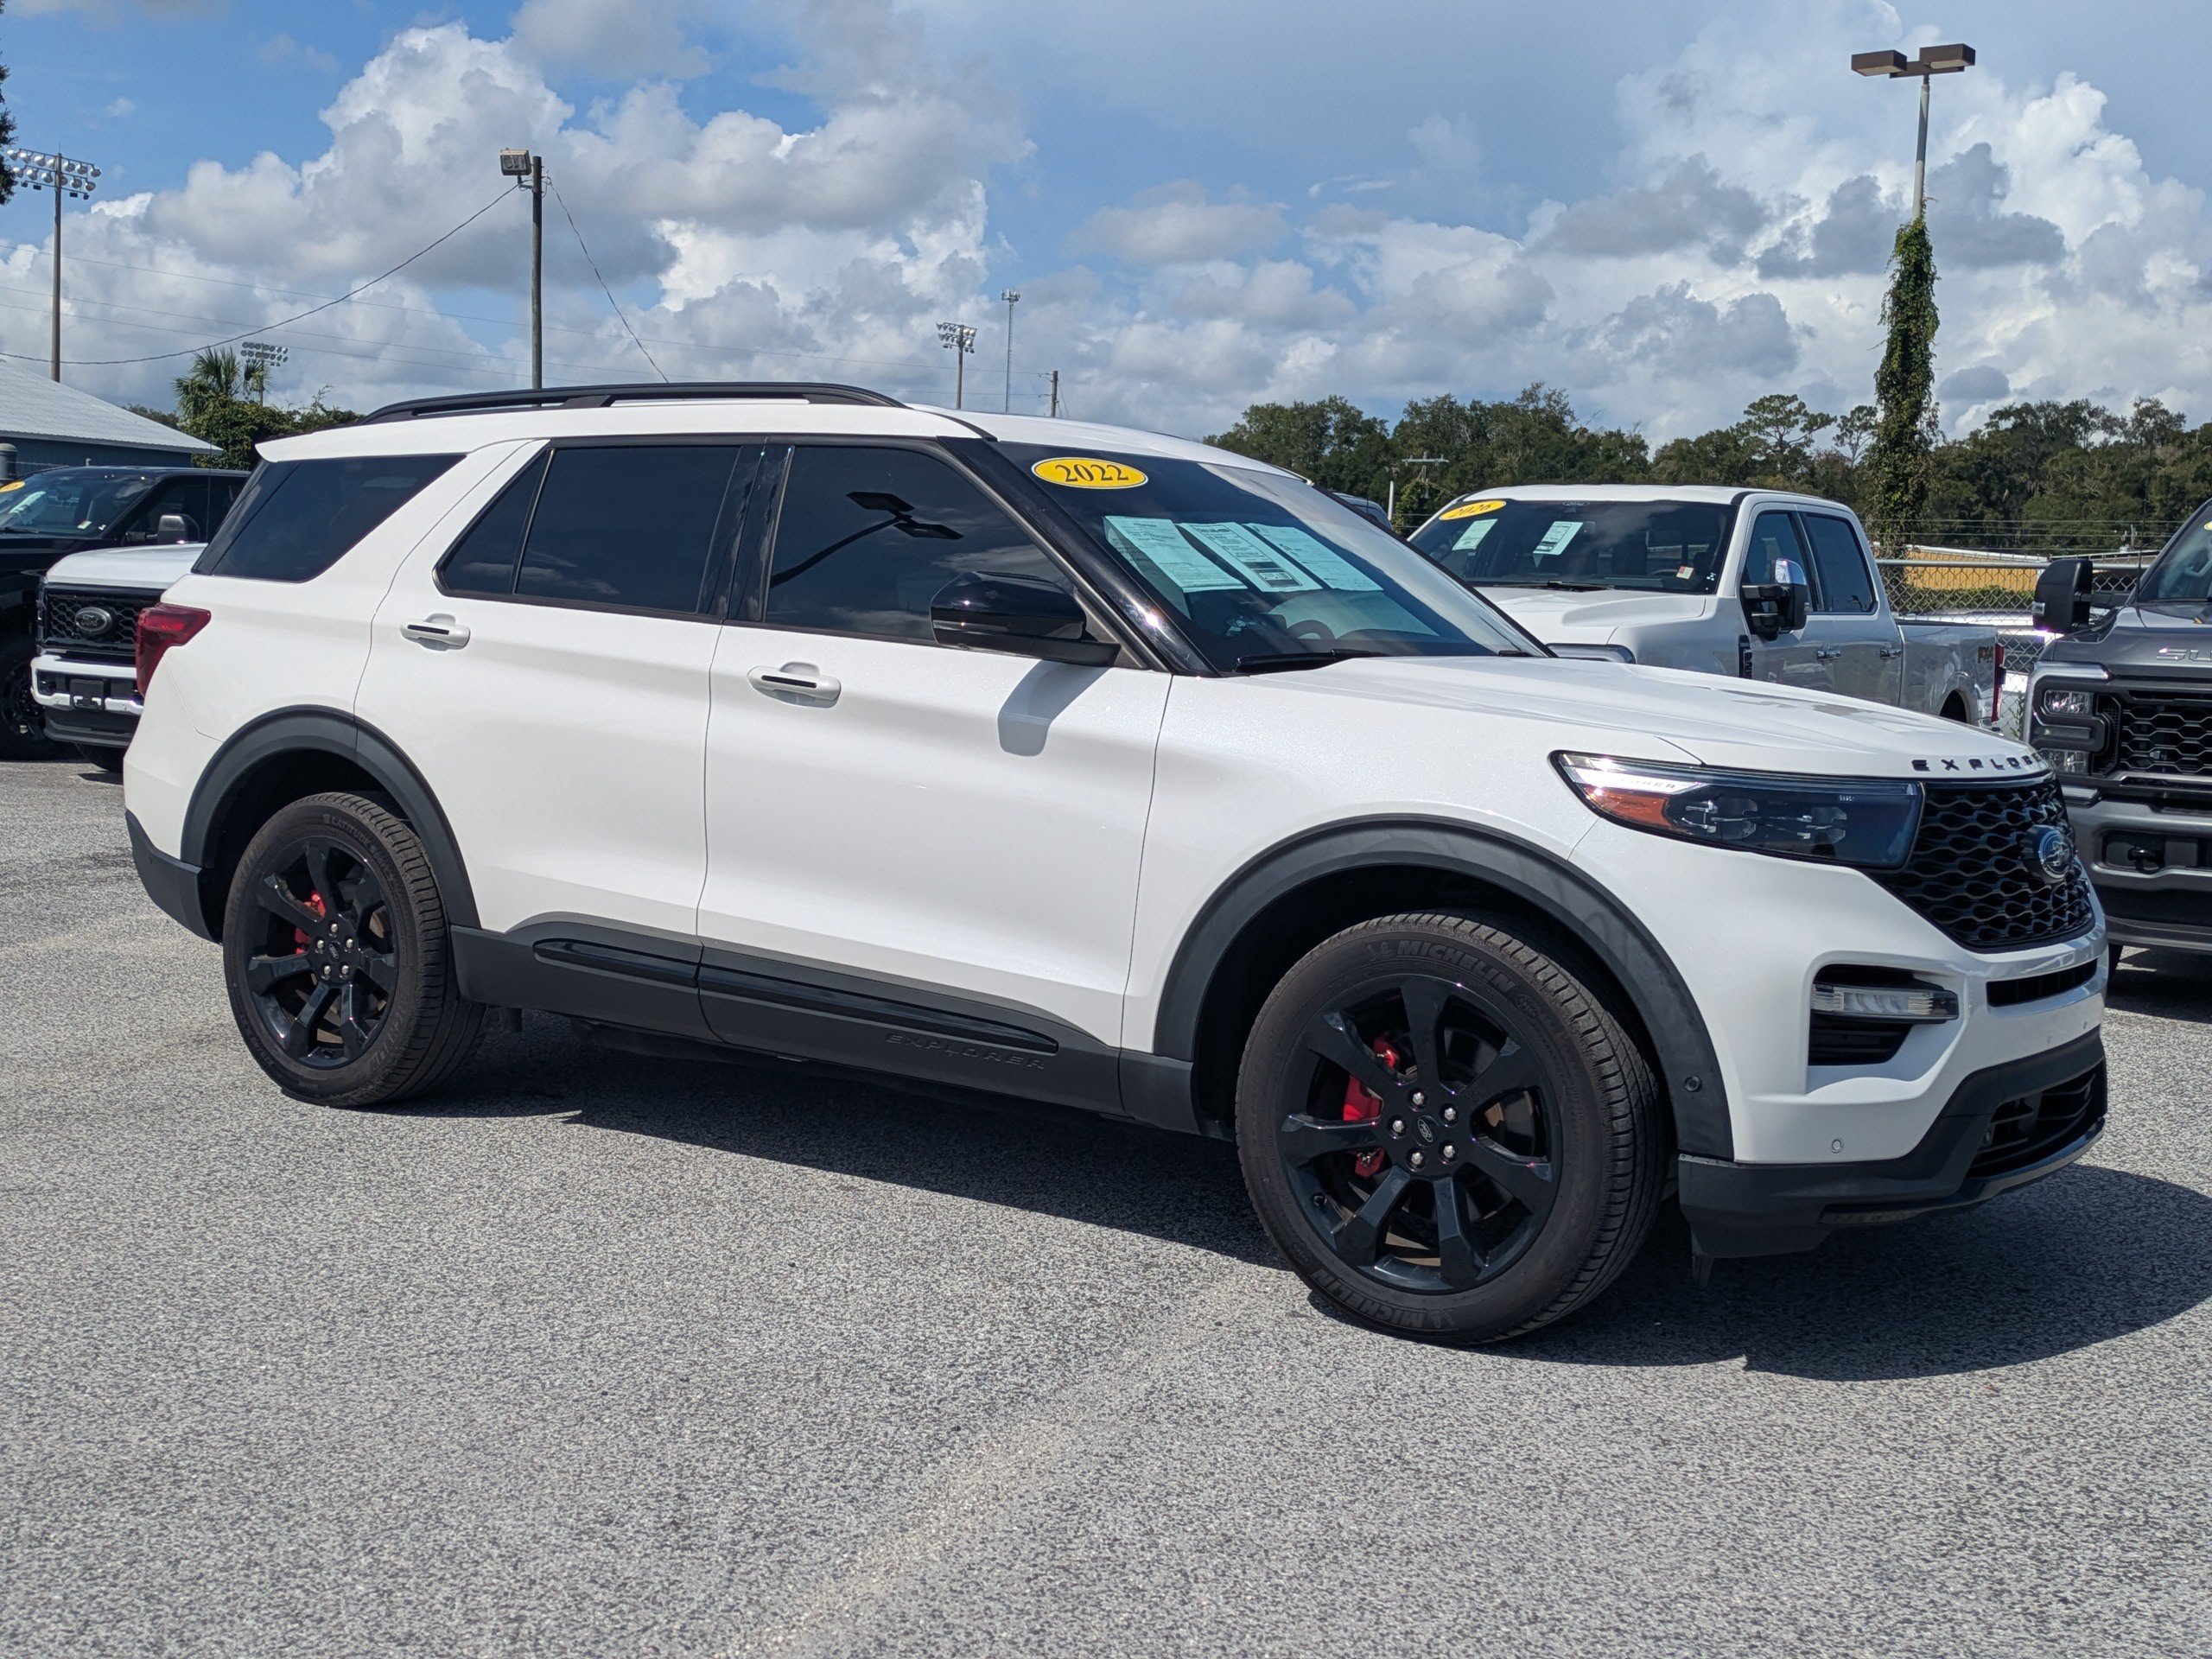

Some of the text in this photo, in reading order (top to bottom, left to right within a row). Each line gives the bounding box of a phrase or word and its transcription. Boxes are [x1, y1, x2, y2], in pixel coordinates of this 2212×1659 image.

[1055, 464, 1129, 482] 2022
[331, 816, 370, 846] LATITUDE
[1396, 939, 1518, 994] MICHELIN
[886, 1034, 1044, 1070] EXPLORER
[1311, 1268, 1426, 1328] MICHELIN
